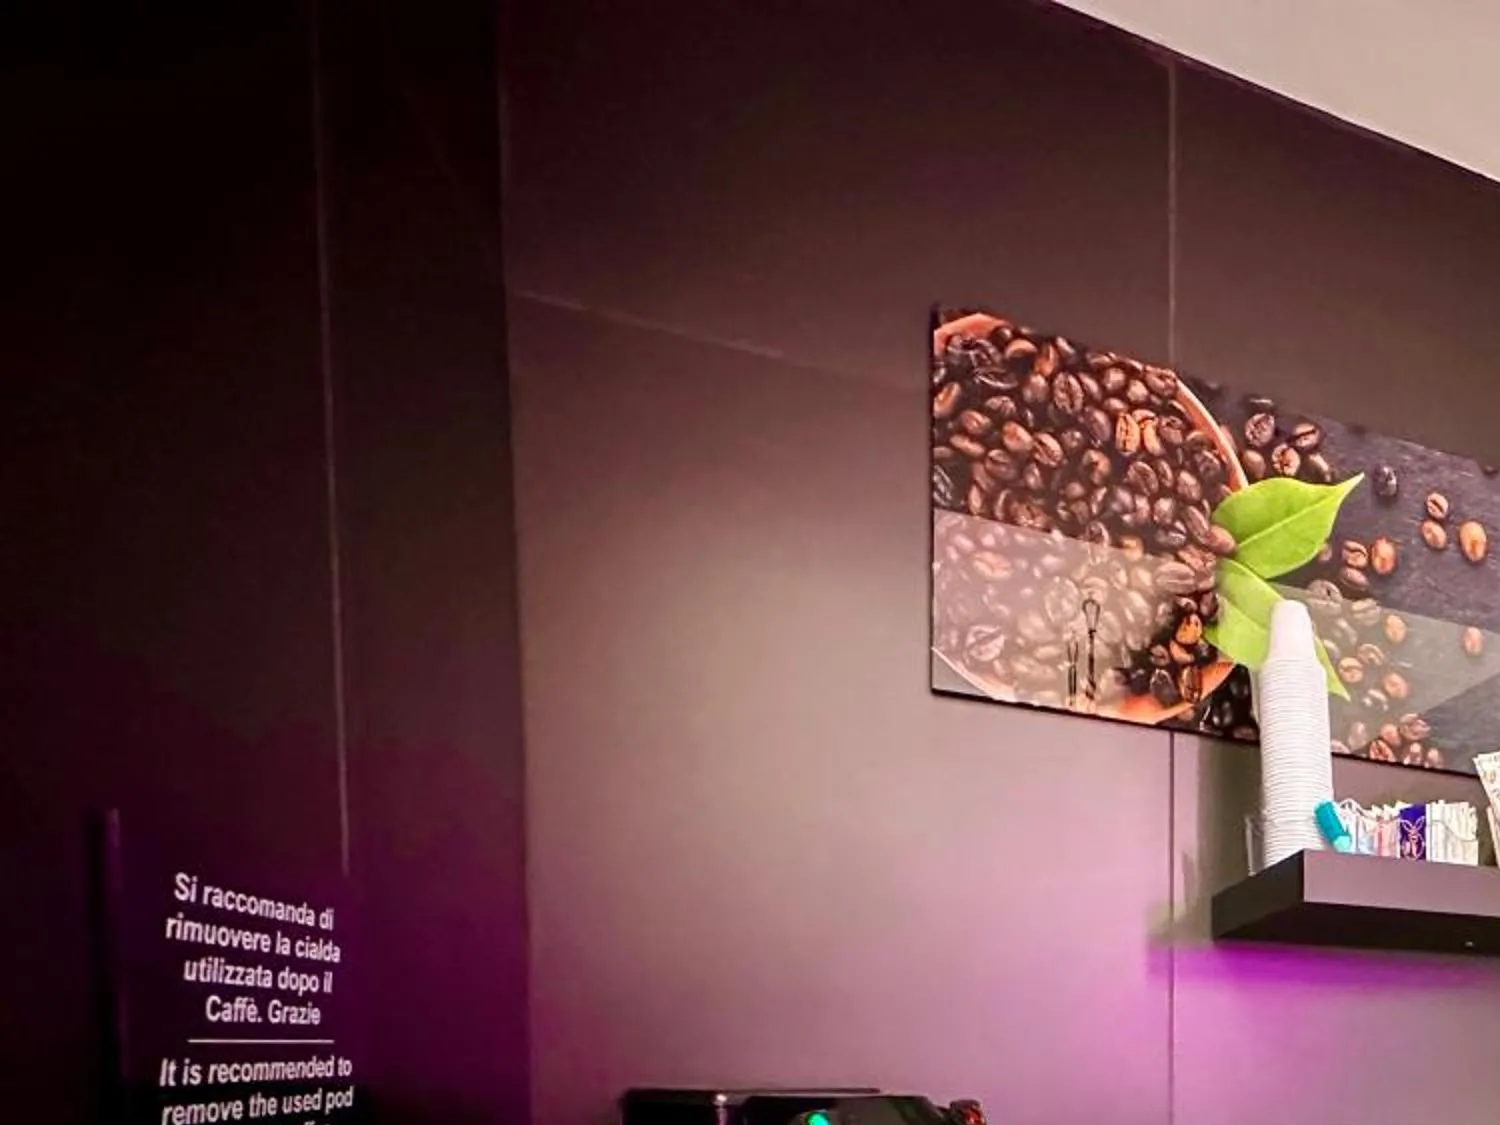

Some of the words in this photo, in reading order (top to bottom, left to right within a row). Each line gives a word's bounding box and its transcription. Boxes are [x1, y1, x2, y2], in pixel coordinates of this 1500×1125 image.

[174, 872, 198, 903] Si
[202, 885, 315, 927] raccomanda
[319, 908, 335, 931] di
[165, 912, 271, 952] rimuovere
[275, 931, 291, 956] la
[295, 936, 341, 963] cialda
[184, 955, 273, 989] utilizzata
[277, 966, 319, 997] dopo
[323, 971, 333, 993] il
[205, 995, 263, 1023] Caffè.
[268, 999, 321, 1025] Grazie
[159, 1058, 177, 1087] It
[182, 1058, 202, 1086] is
[208, 1055, 335, 1085] recommended
[337, 1056, 352, 1077] to
[249, 1091, 278, 1118] the
[282, 1088, 322, 1114] used
[325, 1085, 354, 1116] pod
